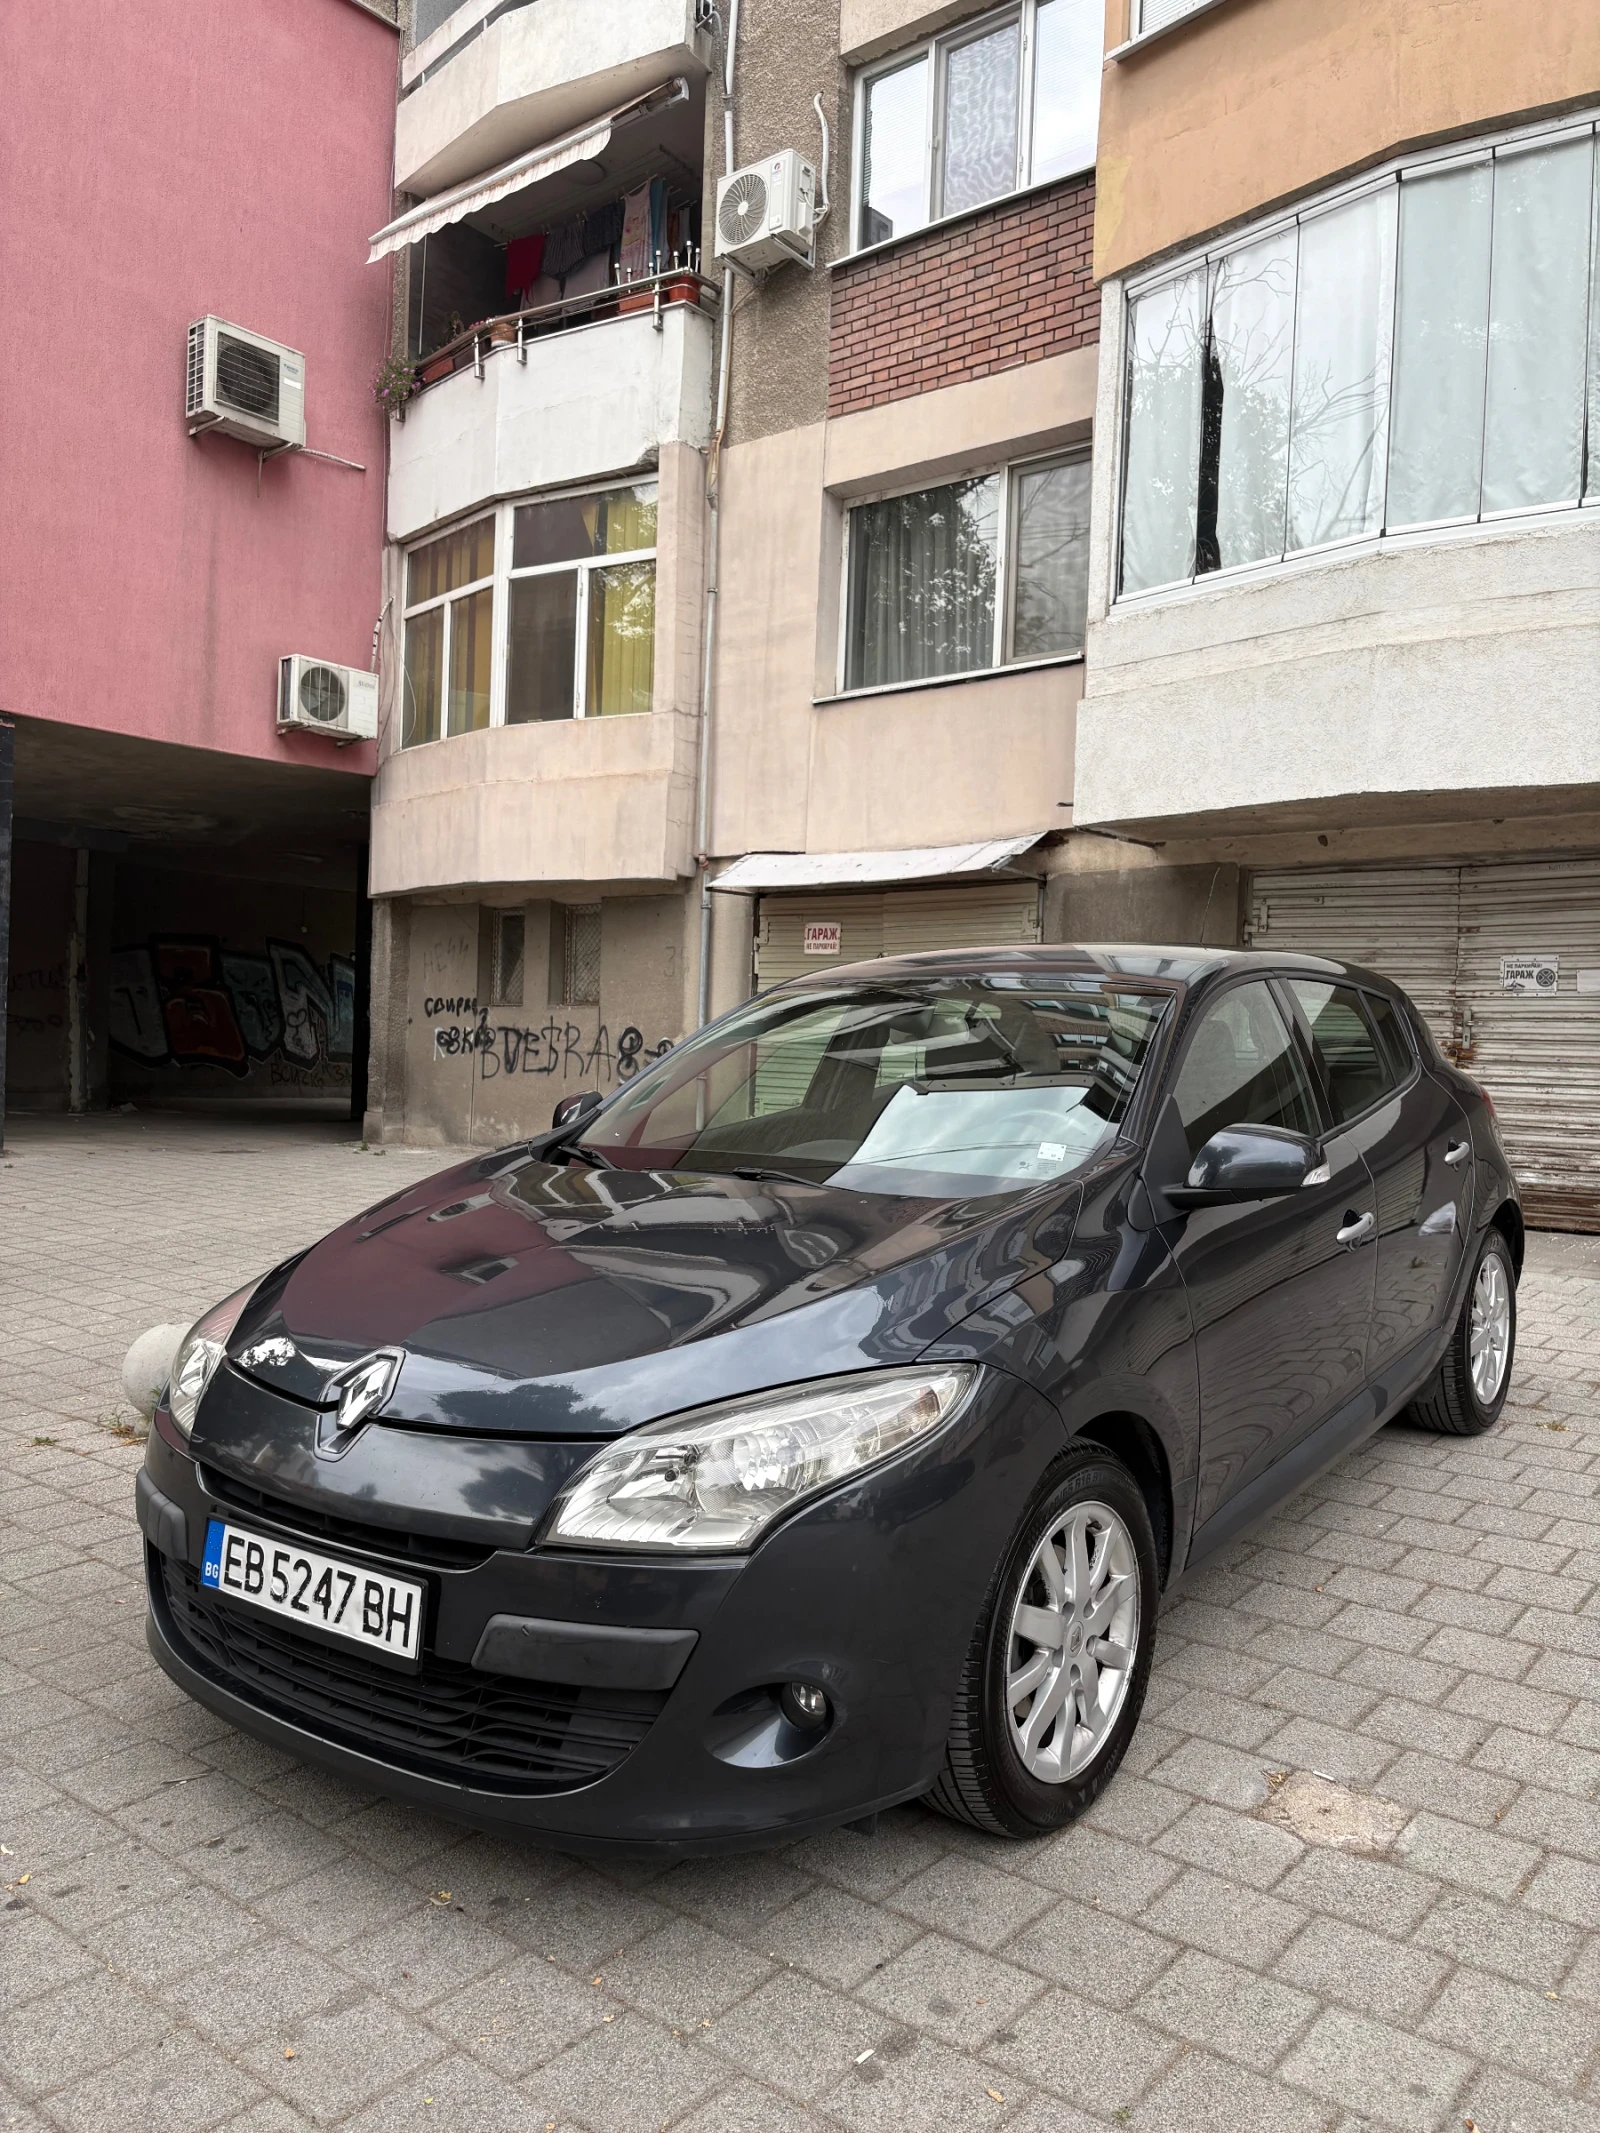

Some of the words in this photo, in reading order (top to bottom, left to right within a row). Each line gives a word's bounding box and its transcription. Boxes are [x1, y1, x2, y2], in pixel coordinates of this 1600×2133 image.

[807, 928, 838, 940] ГАРАЖ
[1505, 970, 1534, 979] ГАРАЖ
[205, 1562, 219, 1579] BG
[223, 1534, 264, 1595] EB
[270, 1549, 357, 1624] 5247
[362, 1579, 413, 1648] BH
